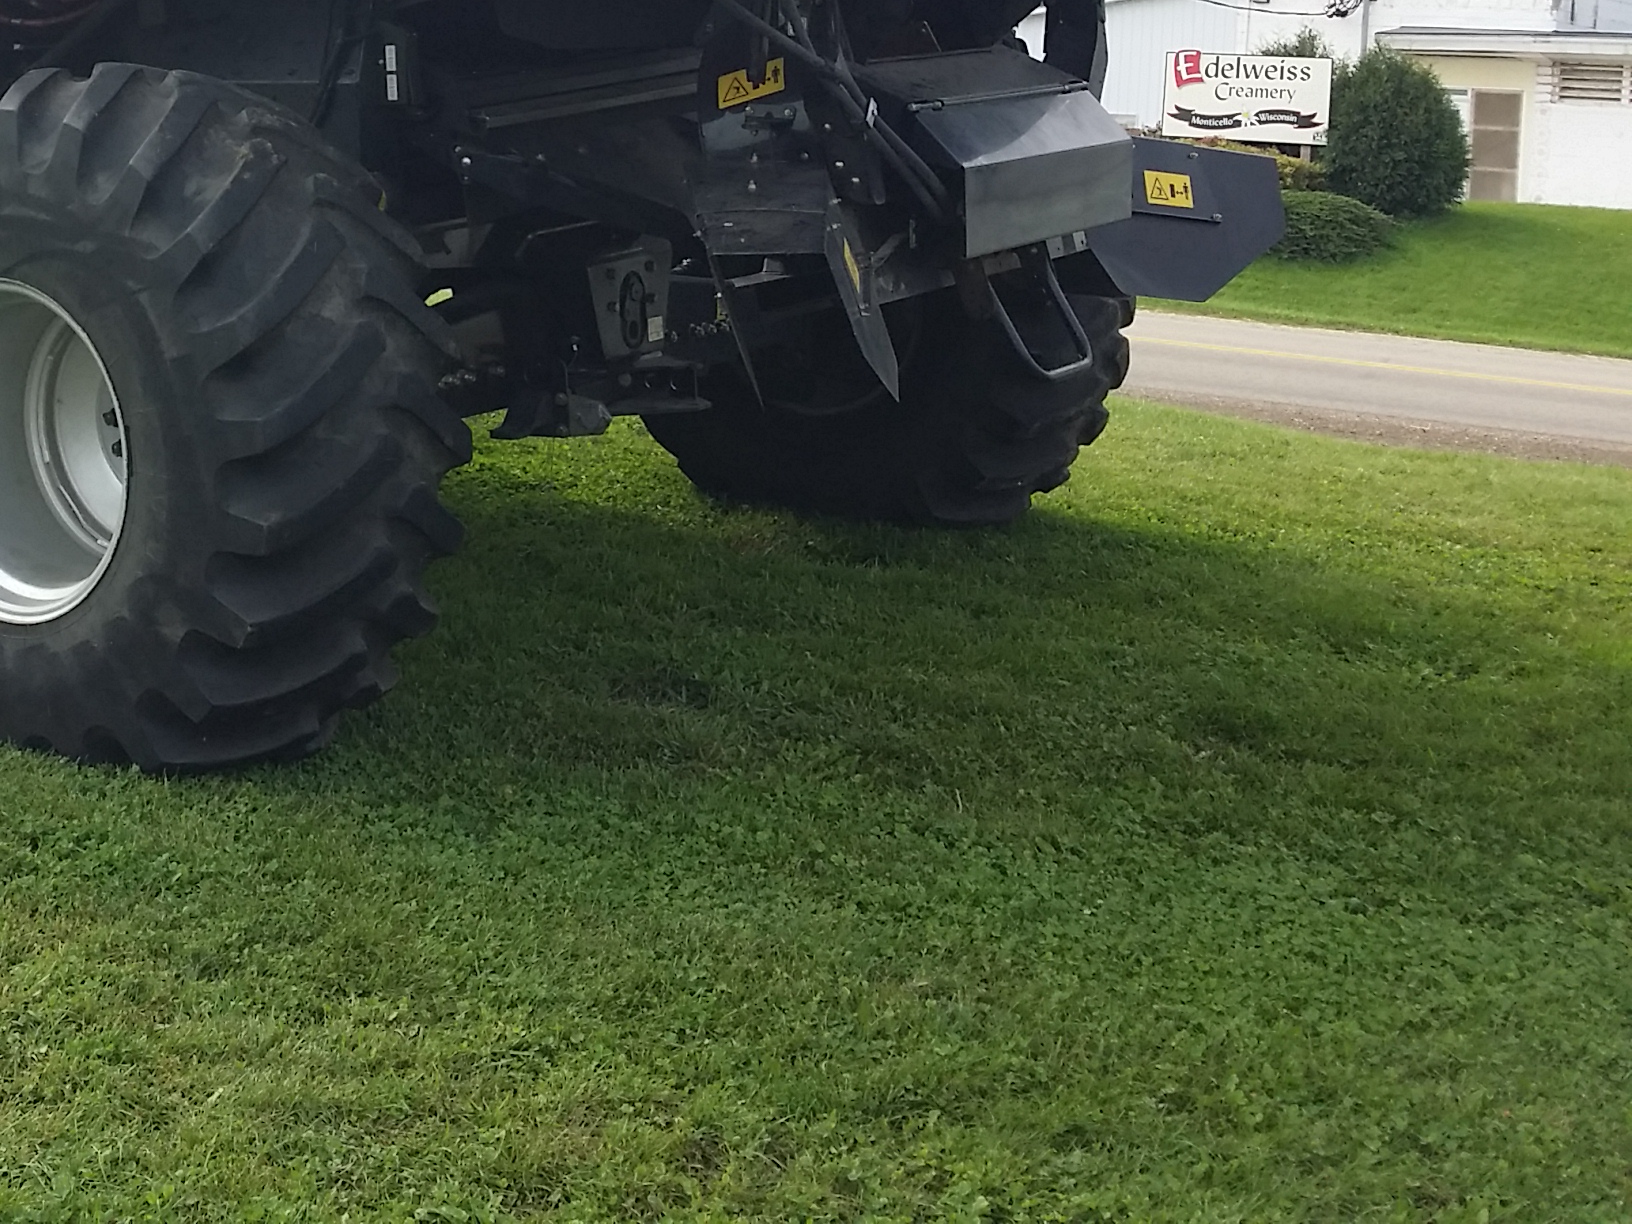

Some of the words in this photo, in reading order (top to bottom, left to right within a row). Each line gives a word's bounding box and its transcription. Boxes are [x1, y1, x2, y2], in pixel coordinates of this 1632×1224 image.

[1176, 51, 1312, 82] Edelweiss
[1214, 82, 1297, 104] Creamery
[1190, 115, 1234, 127] Monticello
[1258, 112, 1298, 123] Wisconsin
